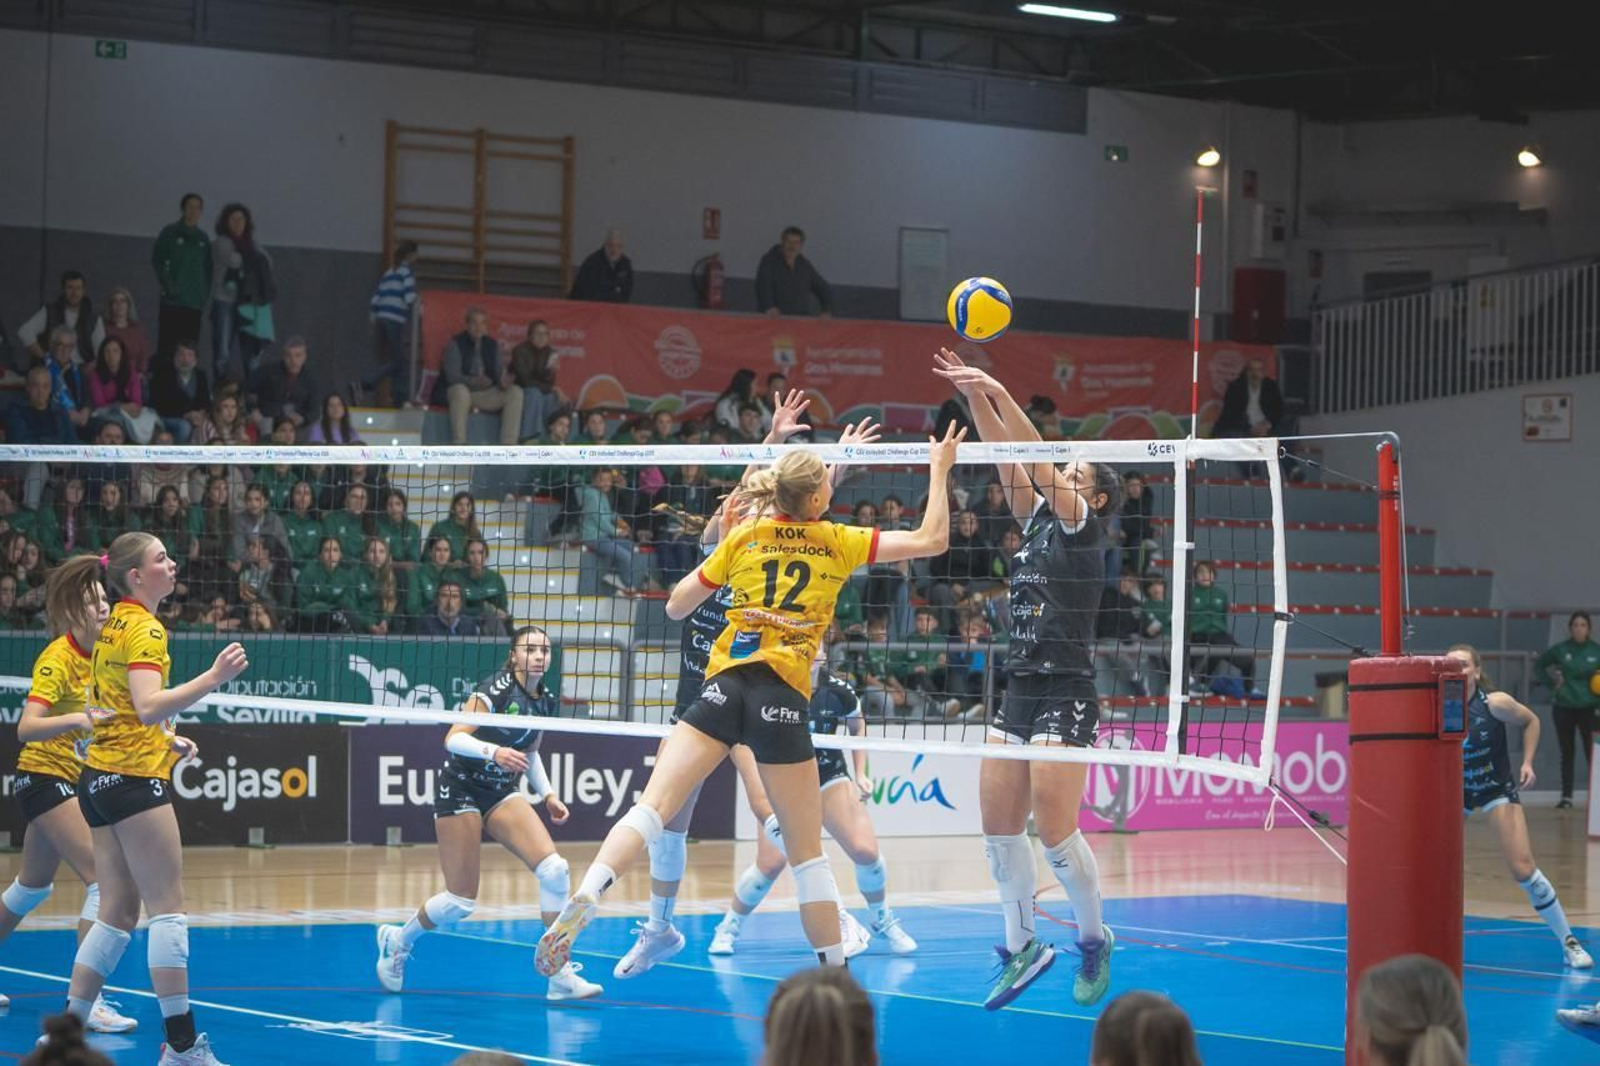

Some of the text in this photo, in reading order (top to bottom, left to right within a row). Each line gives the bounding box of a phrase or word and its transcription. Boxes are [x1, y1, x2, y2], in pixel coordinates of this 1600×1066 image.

[775, 526, 807, 539] KOK
[761, 543, 833, 558] salesdock
[761, 559, 811, 611] 12
[150, 778, 164, 797] 3
[172, 755, 317, 812] Cajasol
